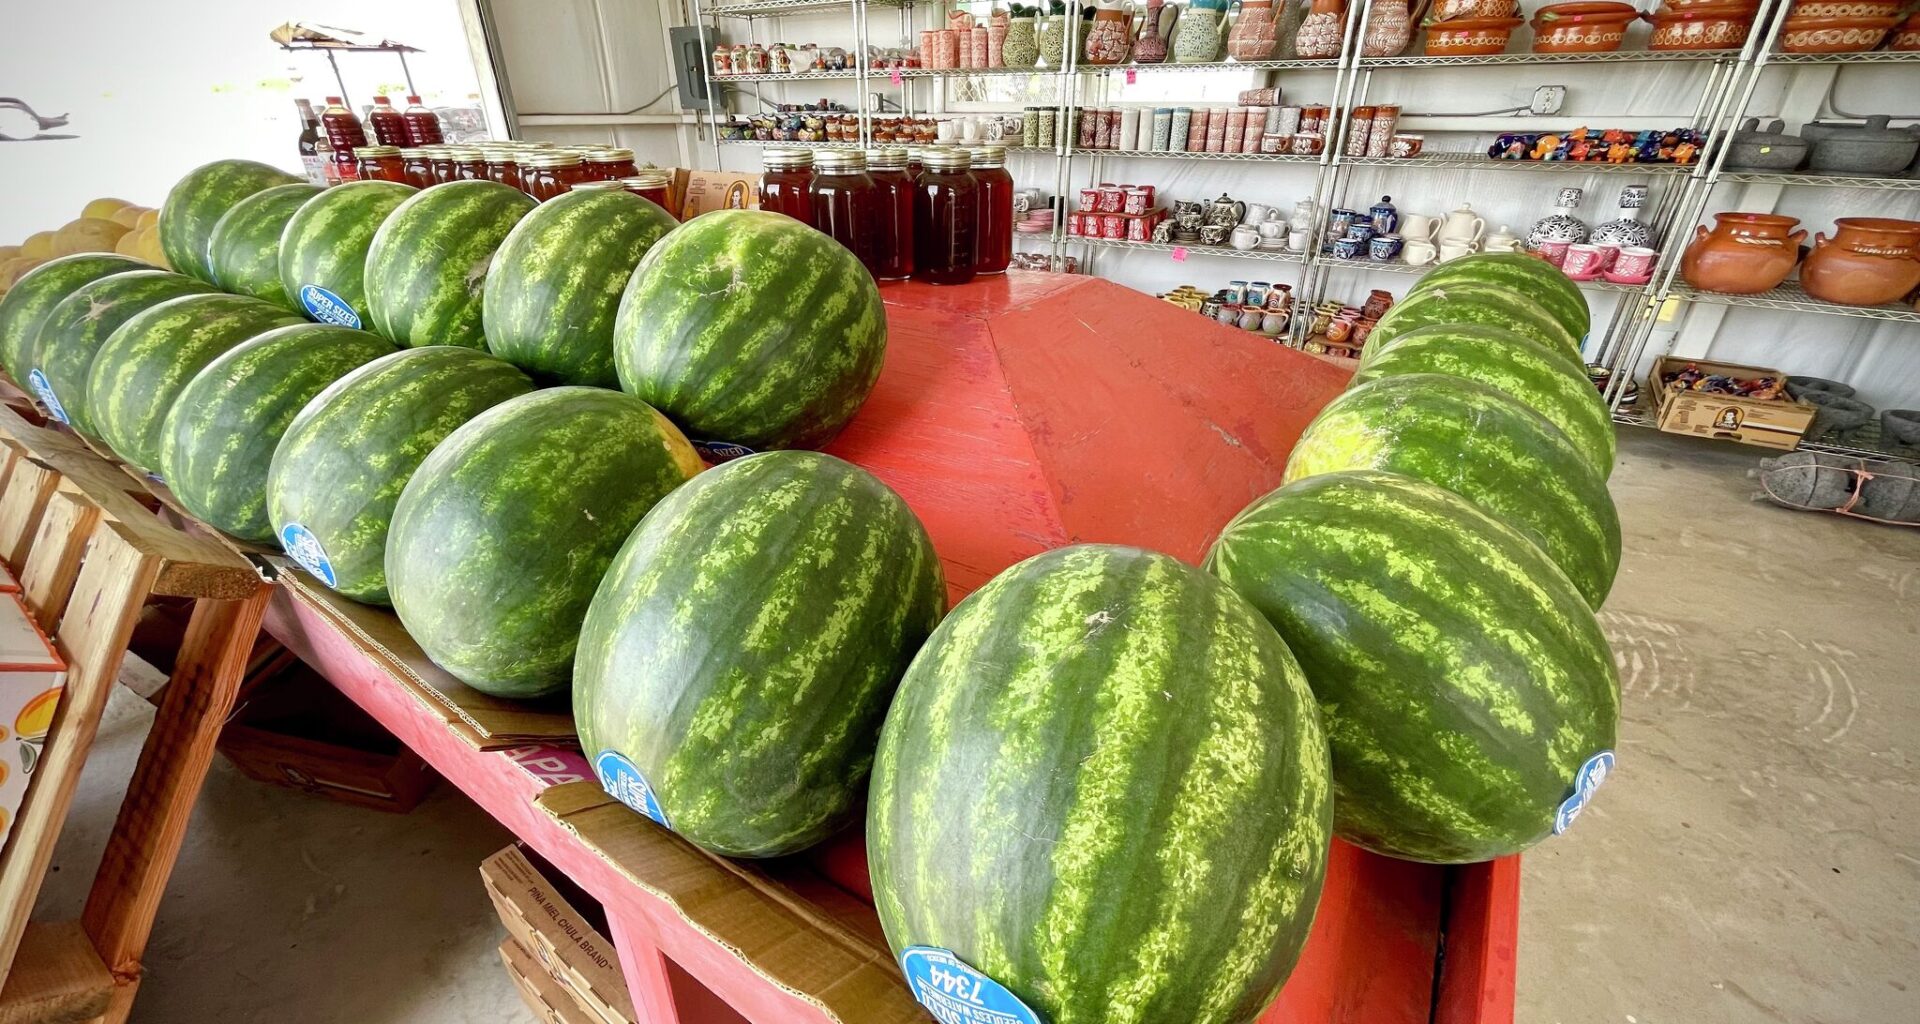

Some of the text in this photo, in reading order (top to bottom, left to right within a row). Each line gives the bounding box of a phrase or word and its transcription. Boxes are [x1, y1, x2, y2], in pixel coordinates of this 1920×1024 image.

[310, 287, 334, 310] SUPER
[333, 304, 357, 324] SIZED
[713, 446, 745, 457] SIZED
[557, 918, 583, 944] CHULA
[929, 964, 985, 1006] 7344
